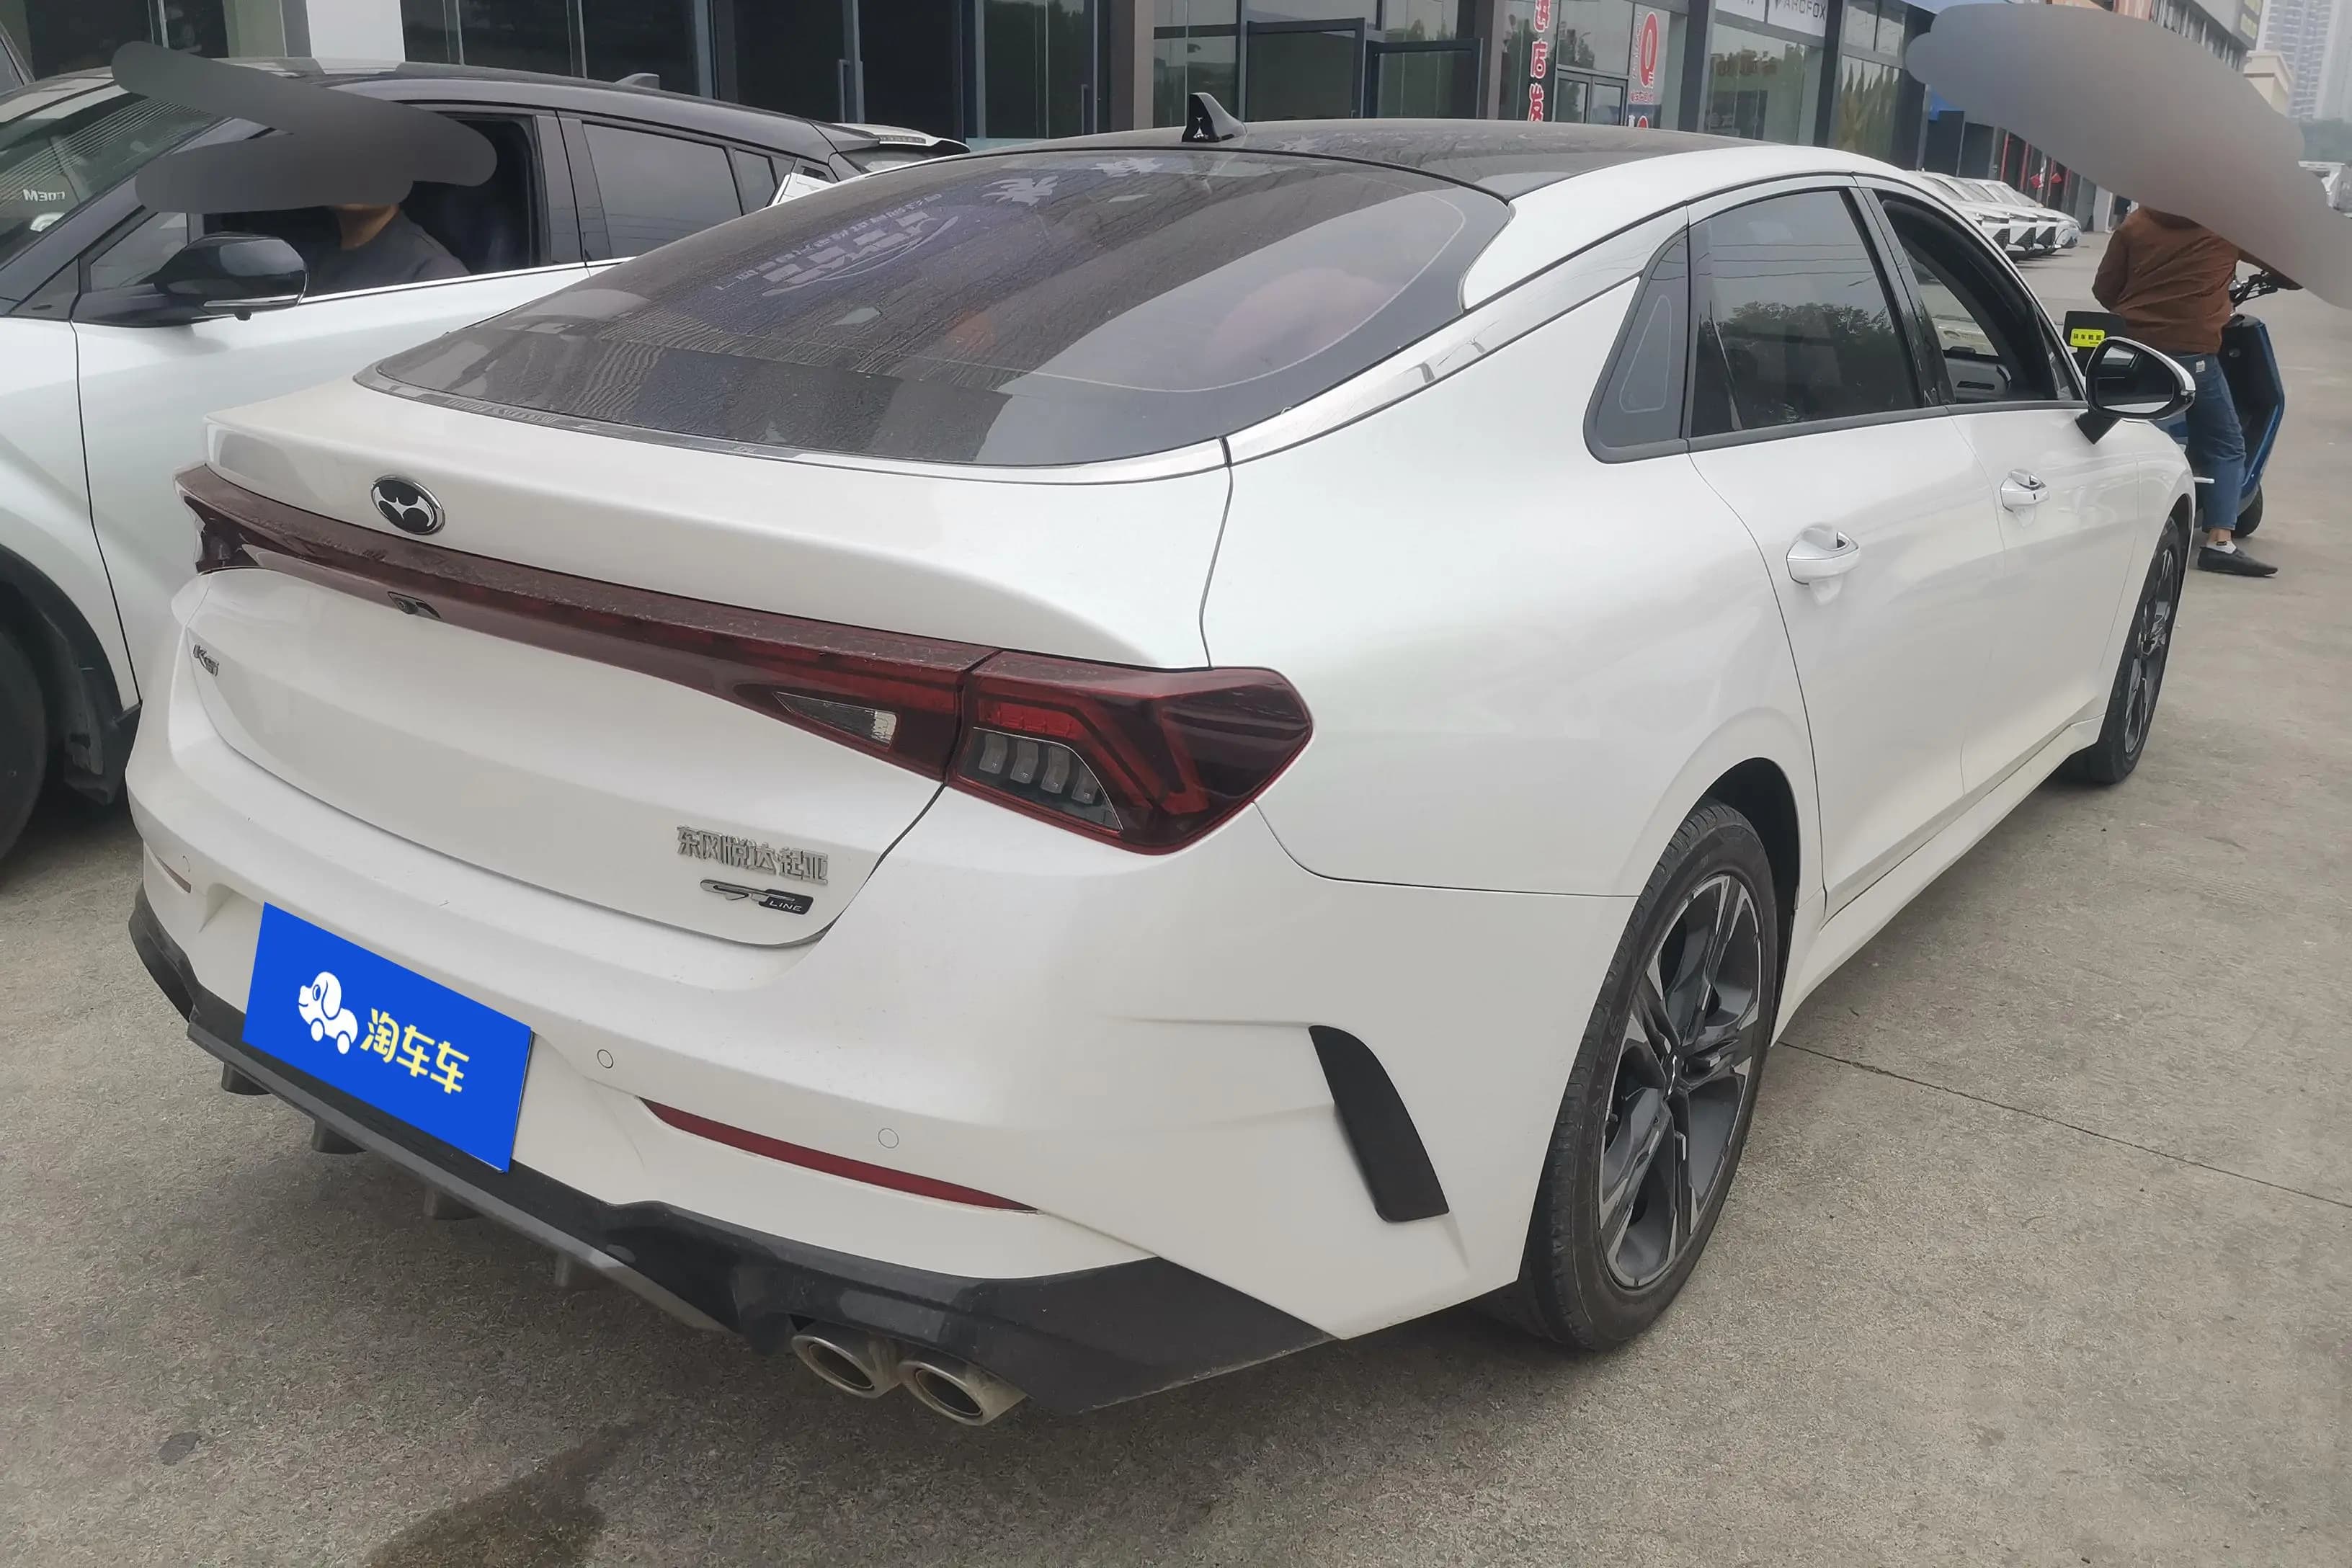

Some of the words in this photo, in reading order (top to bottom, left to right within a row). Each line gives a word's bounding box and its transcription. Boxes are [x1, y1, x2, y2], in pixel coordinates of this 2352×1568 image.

[677, 825, 829, 886] 东风悦达起亚
[769, 900, 803, 912] LINE
